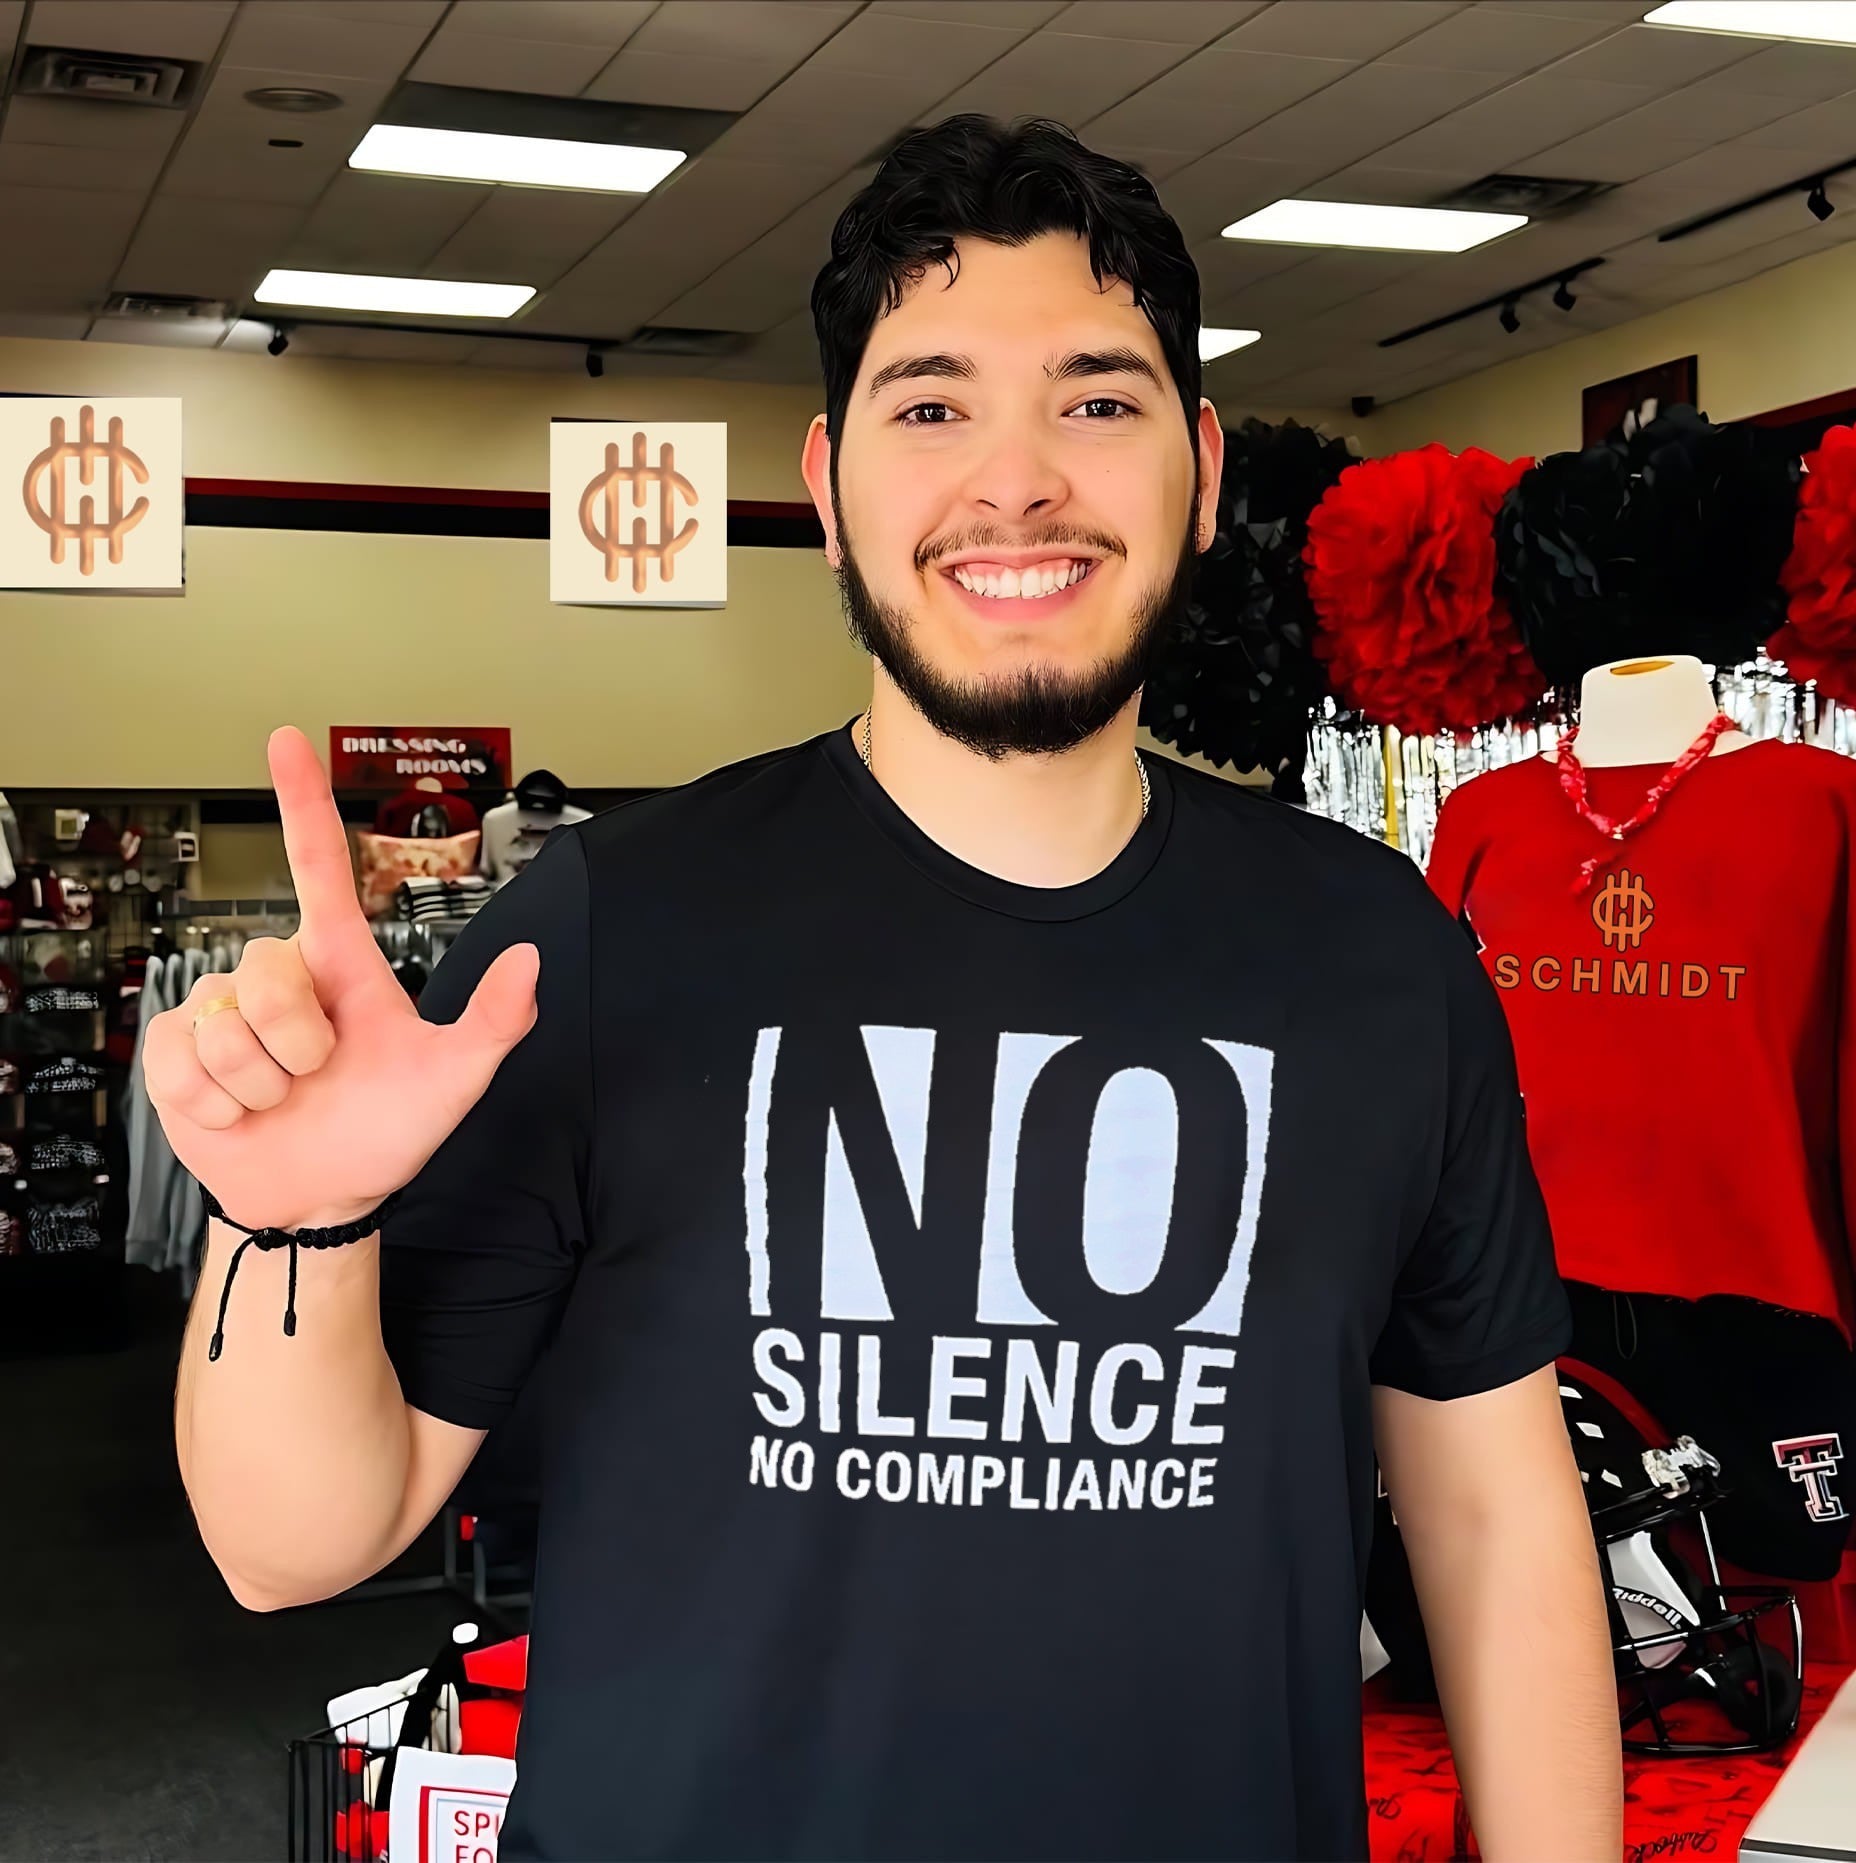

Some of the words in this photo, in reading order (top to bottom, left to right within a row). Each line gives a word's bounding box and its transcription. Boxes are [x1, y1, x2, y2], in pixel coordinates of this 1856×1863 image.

[342, 737, 467, 754] DRESSING
[396, 758, 487, 775] ROOMS
[1493, 953, 1747, 1000] SCHMIDT
[747, 1026, 1272, 1335] NO
[751, 1327, 1237, 1446] SILENCE
[749, 1436, 815, 1492] NO
[836, 1447, 1218, 1511] COMPLIANCE
